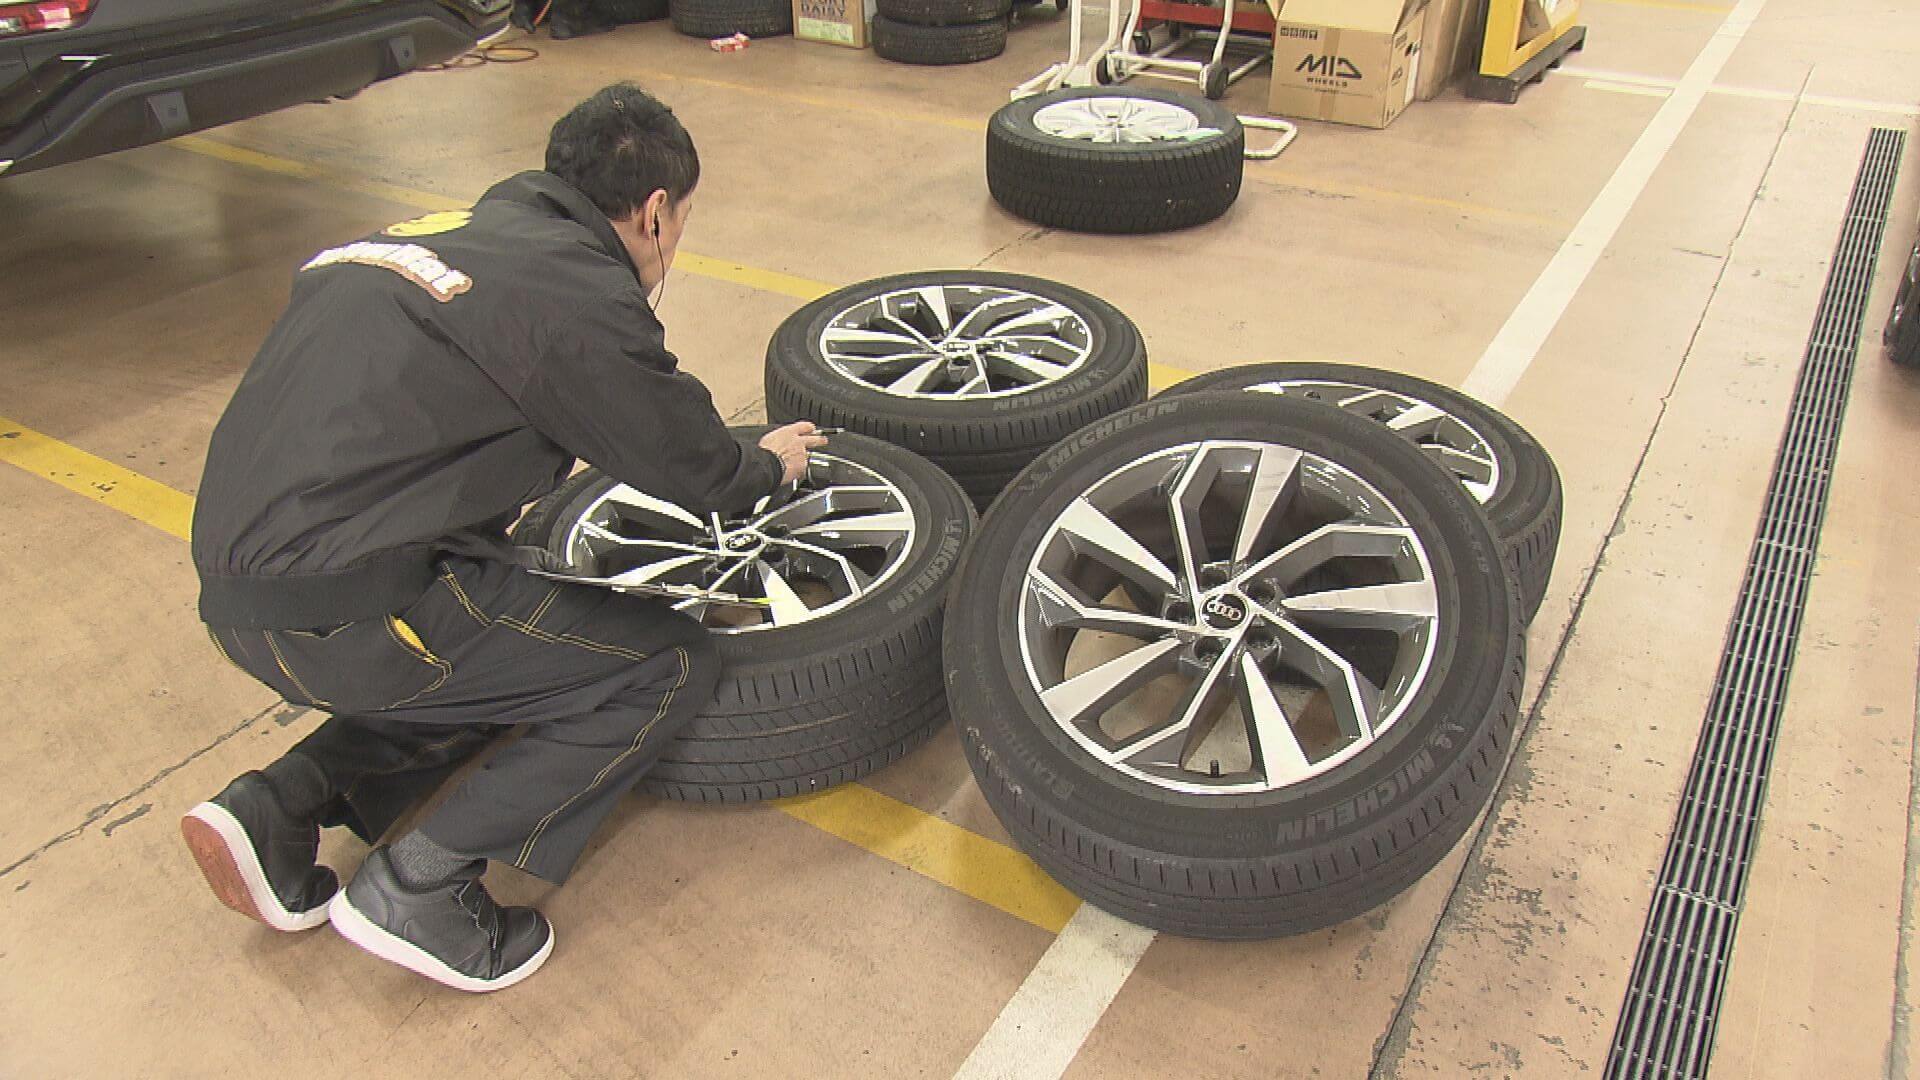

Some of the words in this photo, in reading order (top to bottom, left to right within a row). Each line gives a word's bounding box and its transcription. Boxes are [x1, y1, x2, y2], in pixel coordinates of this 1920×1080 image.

[800, 2, 847, 17] DAIRY
[1294, 53, 1363, 79] MID
[992, 378, 1091, 411] MICHELIN
[1049, 401, 1180, 472] MICHELIN
[887, 535, 961, 615] MICHELIN
[1276, 749, 1437, 844] MICHELIN
